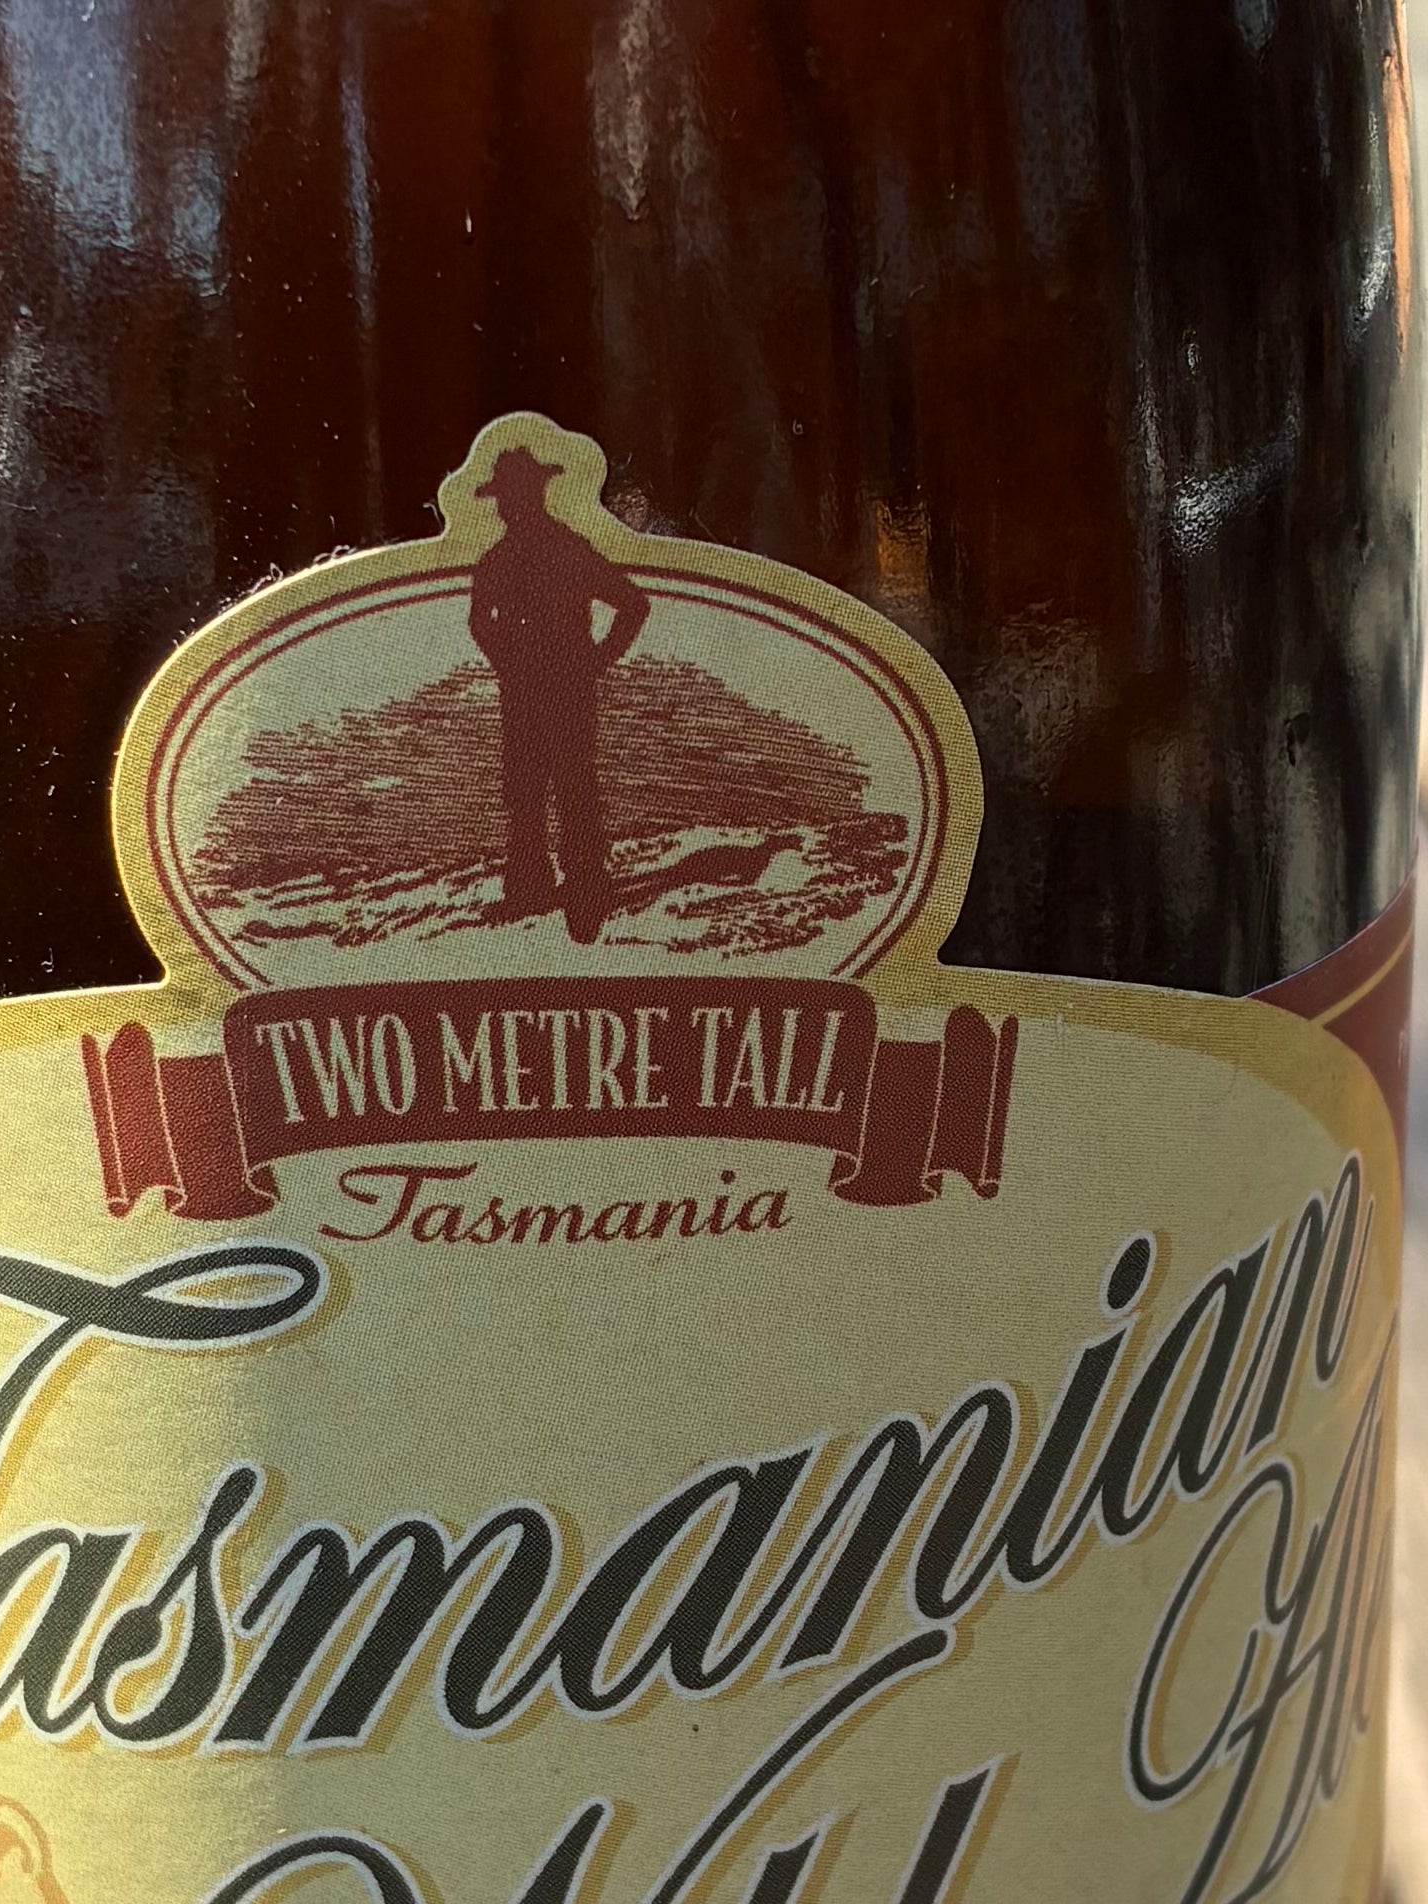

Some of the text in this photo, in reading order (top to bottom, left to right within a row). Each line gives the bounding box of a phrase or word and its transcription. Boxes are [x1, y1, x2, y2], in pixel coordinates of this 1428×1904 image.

[255, 1005, 847, 1125] TWO METRE TALL
[320, 1162, 791, 1244] Tasmania
